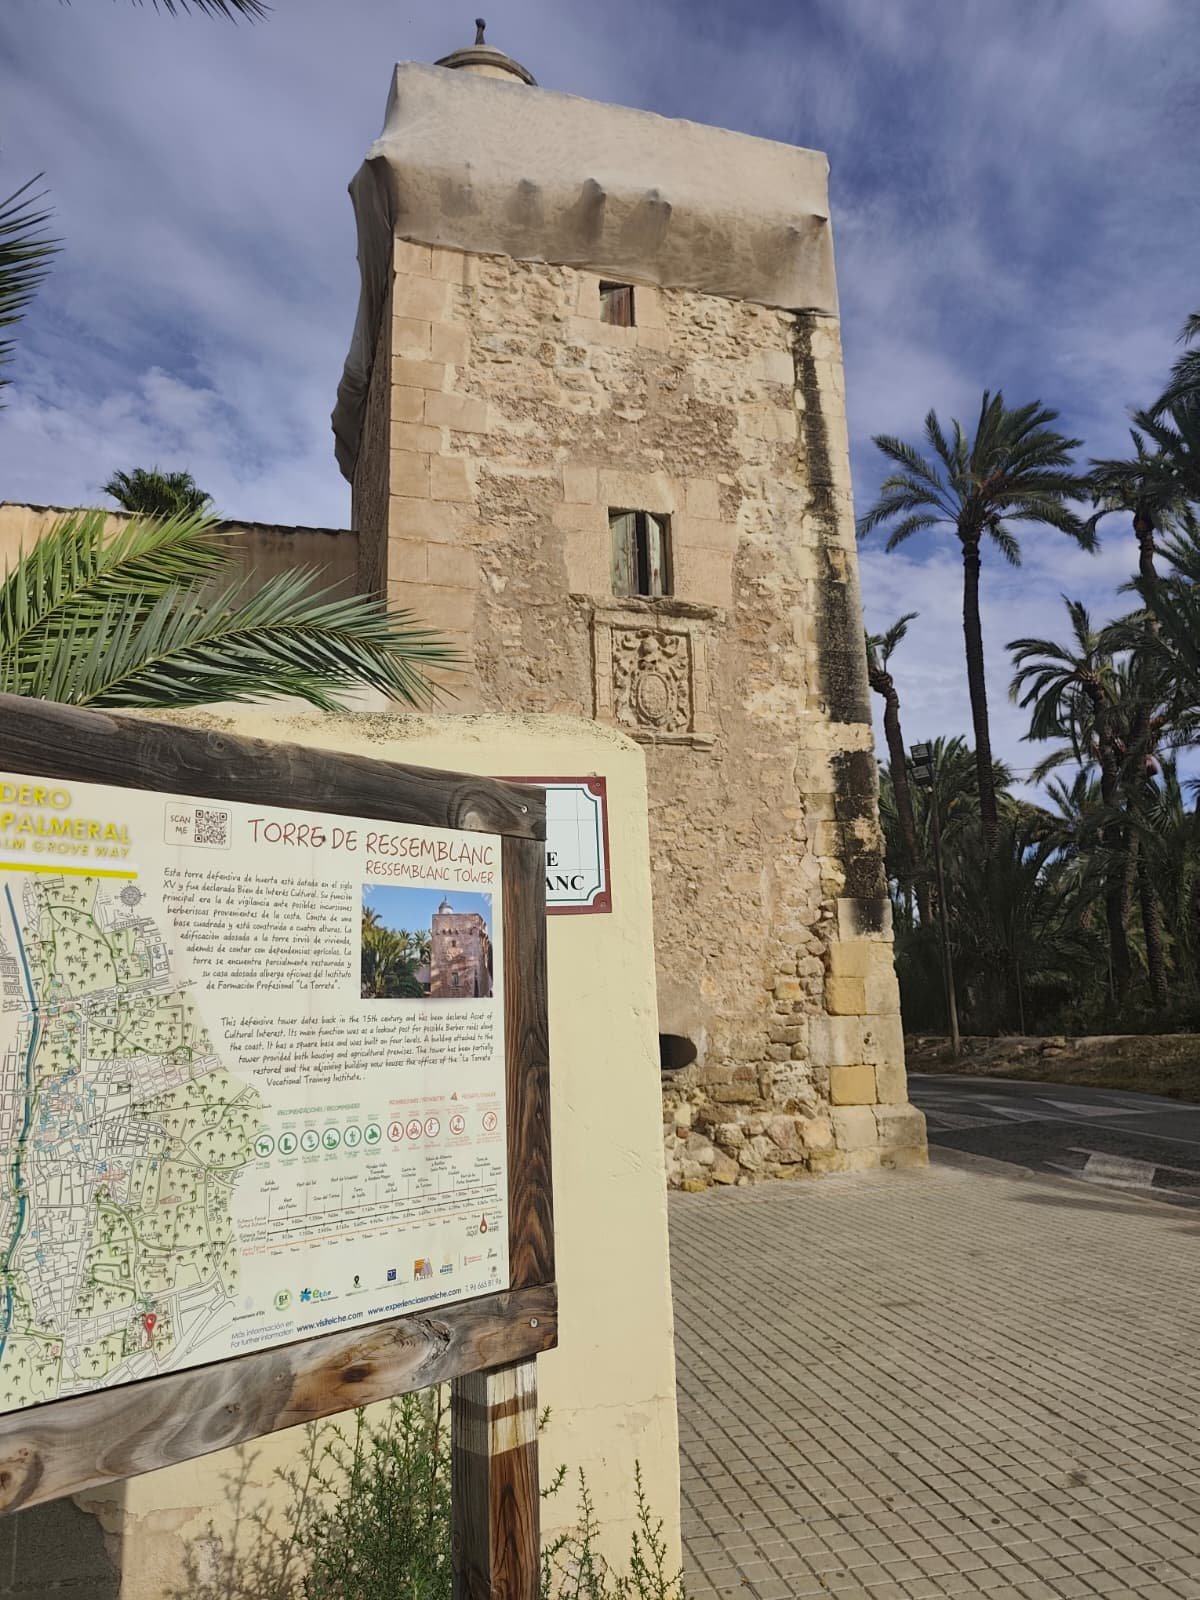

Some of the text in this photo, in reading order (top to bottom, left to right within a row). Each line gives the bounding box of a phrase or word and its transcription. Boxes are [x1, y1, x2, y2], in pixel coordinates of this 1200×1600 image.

[0, 784, 71, 810] DERO
[170, 814, 191, 824] SCAN
[0, 812, 130, 844] PALMERAL
[176, 826, 188, 834] ME
[0, 838, 130, 859] LM GROVE WAY
[248, 818, 494, 866] TORRE DE RESSEMBLANC
[164, 867, 181, 877] Esta
[184, 869, 203, 879] torre
[205, 870, 241, 884] defensiva
[255, 874, 278, 884] huerta
[296, 878, 318, 887] datada
[366, 860, 494, 885] RESSEMBLANC TOWER
[185, 881, 199, 892] fue
[201, 882, 235, 893] declarada
[237, 884, 254, 894] Bien
[162, 892, 195, 905] principal
[238, 896, 270, 909] vigilancia
[273, 900, 288, 908] ante
[167, 905, 209, 916] berberiscas
[306, 912, 326, 921] Consta
[173, 918, 190, 927] base
[193, 919, 226, 928] cuadrada
[296, 924, 316, 932] cuatro
[223, 932, 250, 942] adosada
[272, 934, 289, 943] torre
[229, 945, 252, 953] contar
[192, 956, 212, 965] torre
[227, 957, 262, 965] encuentra
[230, 968, 257, 978] adosada
[259, 968, 284, 980] alberga
[286, 969, 312, 980] oficinas
[313, 969, 323, 978] del
[325, 969, 351, 978] Instituto
[256, 980, 294, 991] Profesional
[220, 1016, 236, 1026] This
[240, 1016, 274, 1027] defensive
[277, 1016, 298, 1025] tower
[301, 1016, 318, 1024] dates
[321, 1016, 336, 1024] back
[363, 1014, 378, 1023] 15th
[380, 1015, 403, 1024] century
[405, 1013, 416, 1022] and
[430, 1013, 443, 1021] been
[446, 1012, 468, 1021] declared
[470, 1012, 484, 1020] Asset
[224, 1029, 254, 1038] Cultural
[256, 1029, 286, 1037] Interest.
[288, 1028, 297, 1036] Its
[299, 1027, 316, 1036] main
[318, 1026, 345, 1037] function
[376, 1025, 397, 1033] lookout
[398, 1025, 410, 1035] post
[412, 1024, 422, 1034] for
[445, 1023, 464, 1032] Berber
[230, 1042, 242, 1051] the
[244, 1041, 264, 1050] coast.
[296, 1041, 318, 1050] square
[320, 1038, 334, 1048] base
[336, 1038, 348, 1047] and
[364, 1036, 378, 1046] built
[389, 1035, 403, 1046] four
[238, 1055, 260, 1063] tower
[262, 1052, 292, 1064] provided
[294, 1051, 309, 1061] both
[311, 1050, 334, 1062] housing
[336, 1049, 348, 1058] and
[350, 1048, 385, 1060] agricultural
[416, 1045, 427, 1054] The
[253, 1064, 282, 1075] restored
[284, 1064, 297, 1073] and
[299, 1064, 310, 1072] the
[344, 1059, 368, 1070] building
[415, 1056, 438, 1067] offices
[266, 1075, 302, 1086] Vocational
[303, 1073, 331, 1085] Training
[297, 1312, 364, 1334] www.visitelche.com
